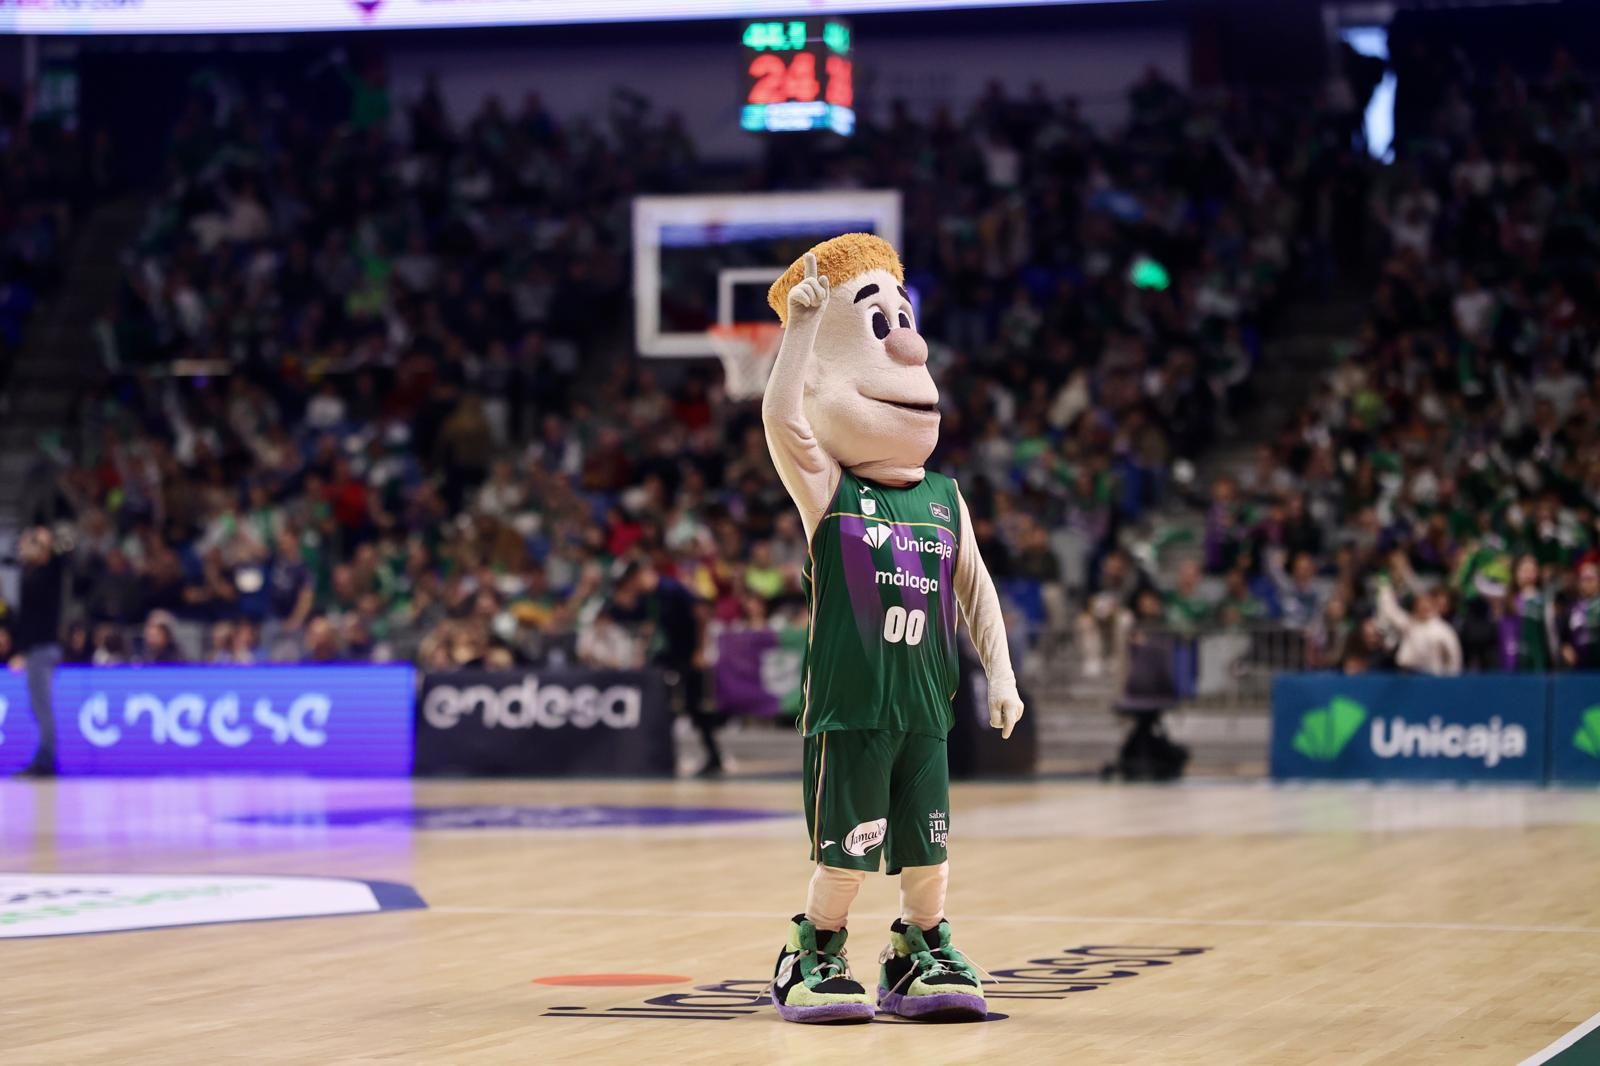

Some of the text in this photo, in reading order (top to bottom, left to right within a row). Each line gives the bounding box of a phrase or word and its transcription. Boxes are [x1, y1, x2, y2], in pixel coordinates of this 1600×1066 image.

[748, 53, 820, 104] 24
[896, 536, 952, 560] Unicaja
[875, 567, 938, 594] málaga
[884, 606, 926, 646] 00
[423, 674, 643, 730] endesa
[1370, 715, 1528, 767] Unicaja
